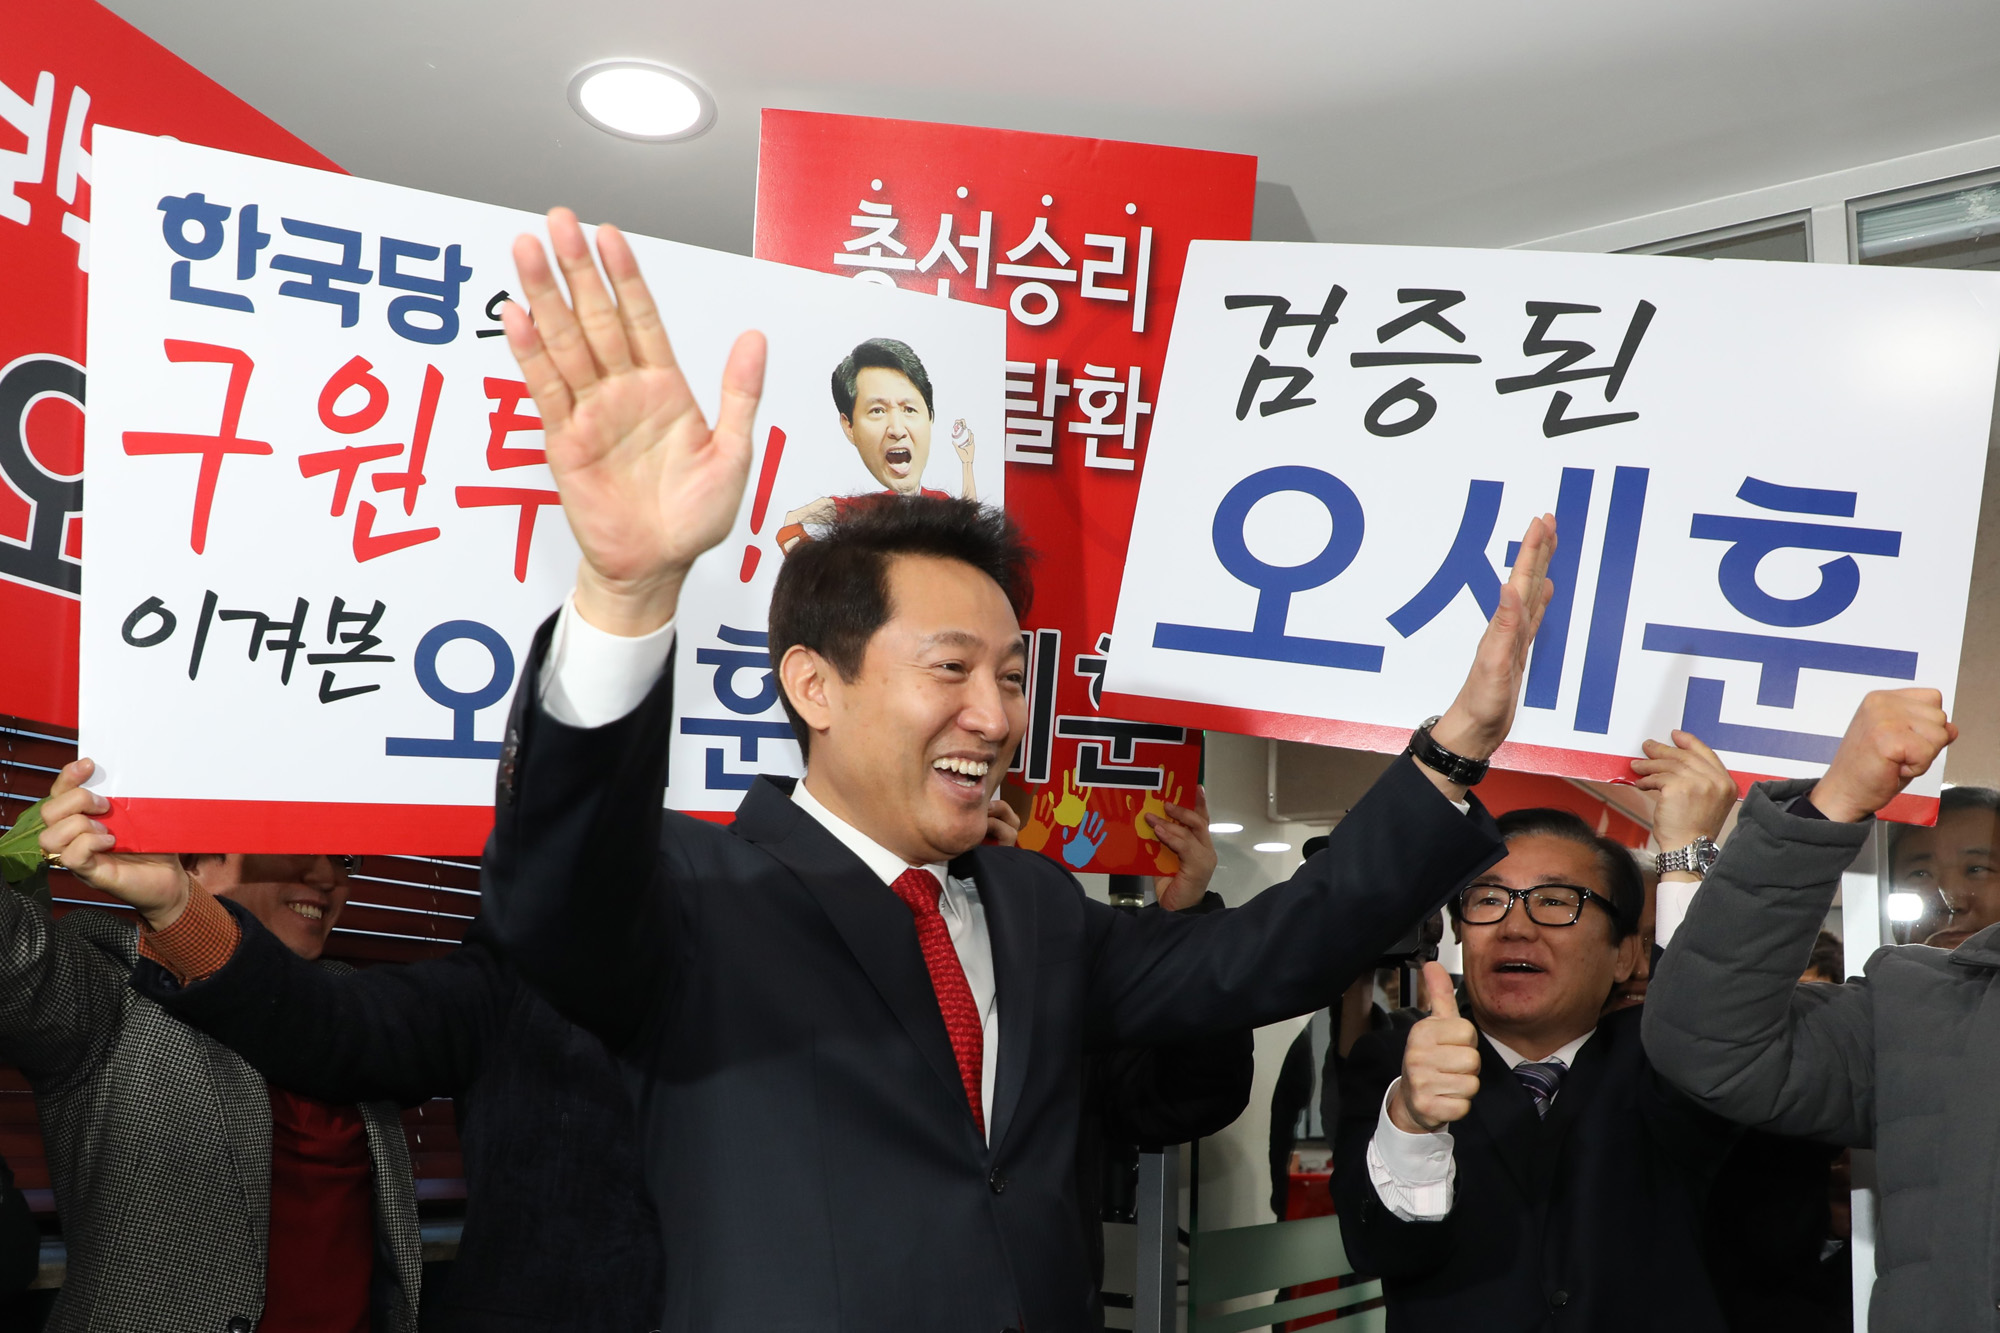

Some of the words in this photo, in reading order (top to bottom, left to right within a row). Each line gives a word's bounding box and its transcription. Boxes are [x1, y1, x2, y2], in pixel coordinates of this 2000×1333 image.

[1005, 358, 1152, 471] 탈환
[1224, 284, 1656, 438] 검증된
[121, 590, 395, 703] 이겨본
[1153, 465, 1919, 766] 오세훈
